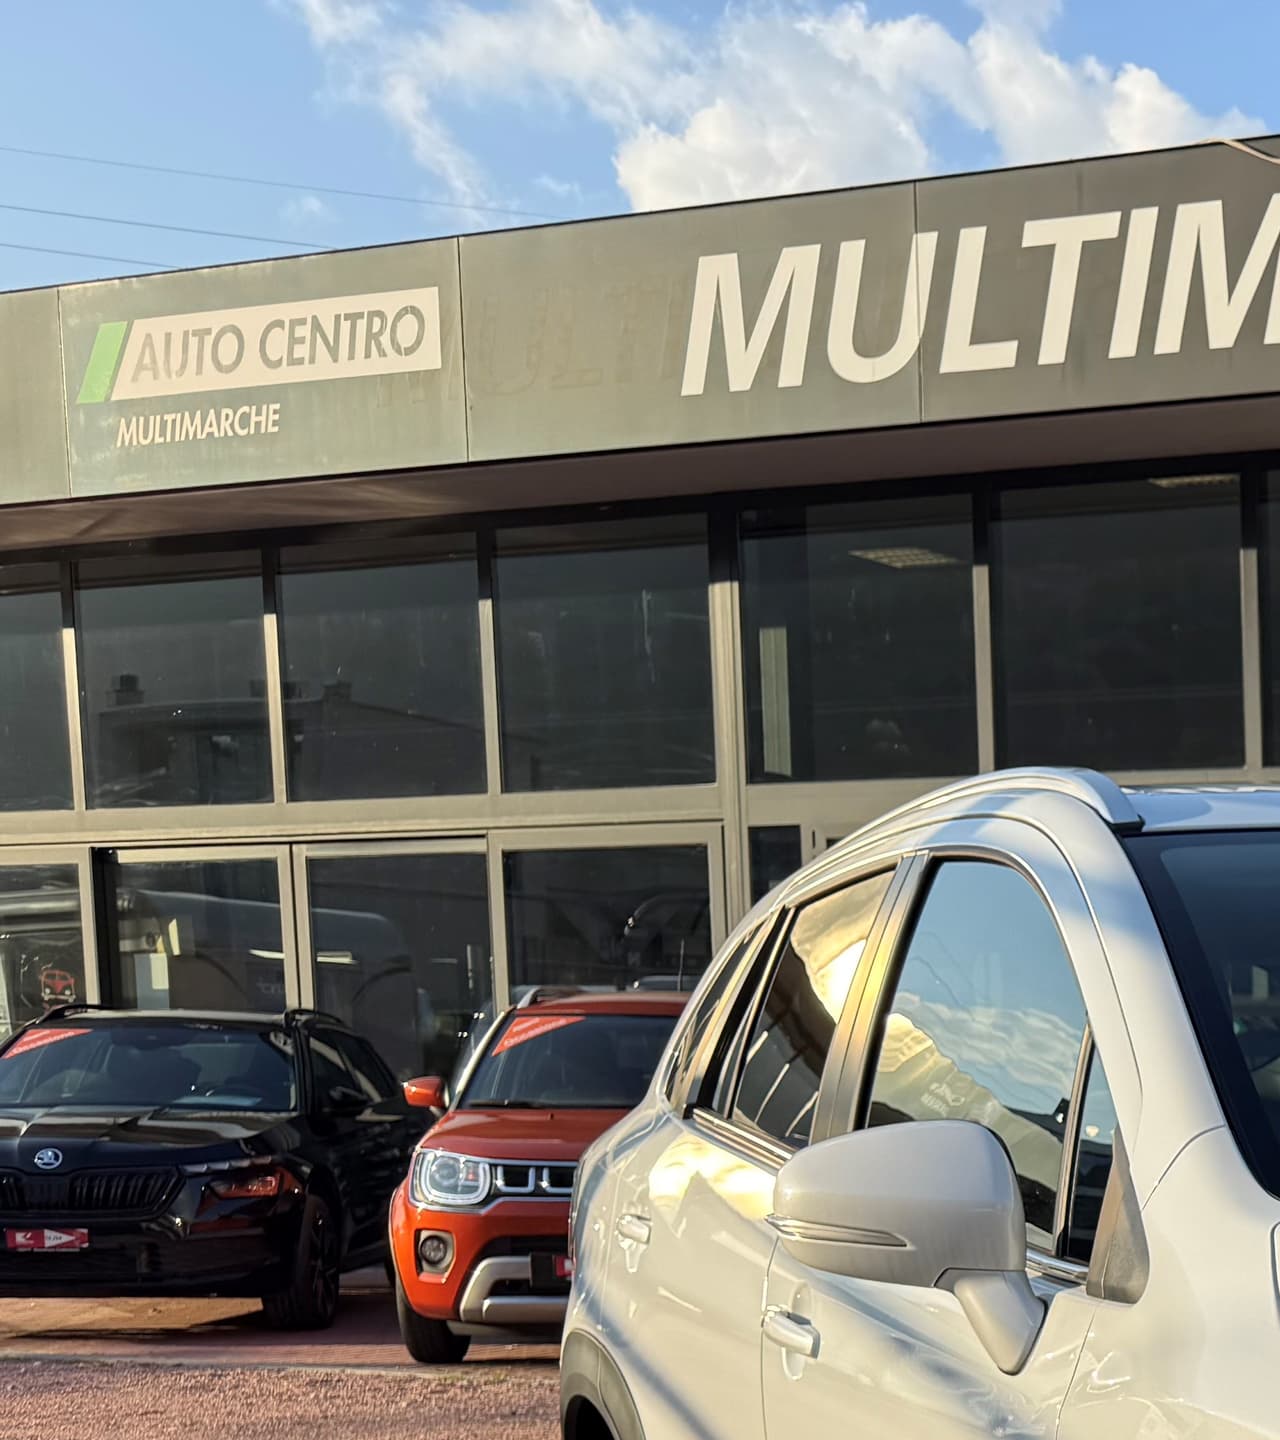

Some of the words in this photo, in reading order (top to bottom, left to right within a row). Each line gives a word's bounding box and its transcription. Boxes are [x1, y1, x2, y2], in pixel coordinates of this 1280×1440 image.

[130, 323, 245, 383] AUTO
[258, 304, 426, 370] CENTRO
[116, 403, 281, 449] MULTIMARCHE
